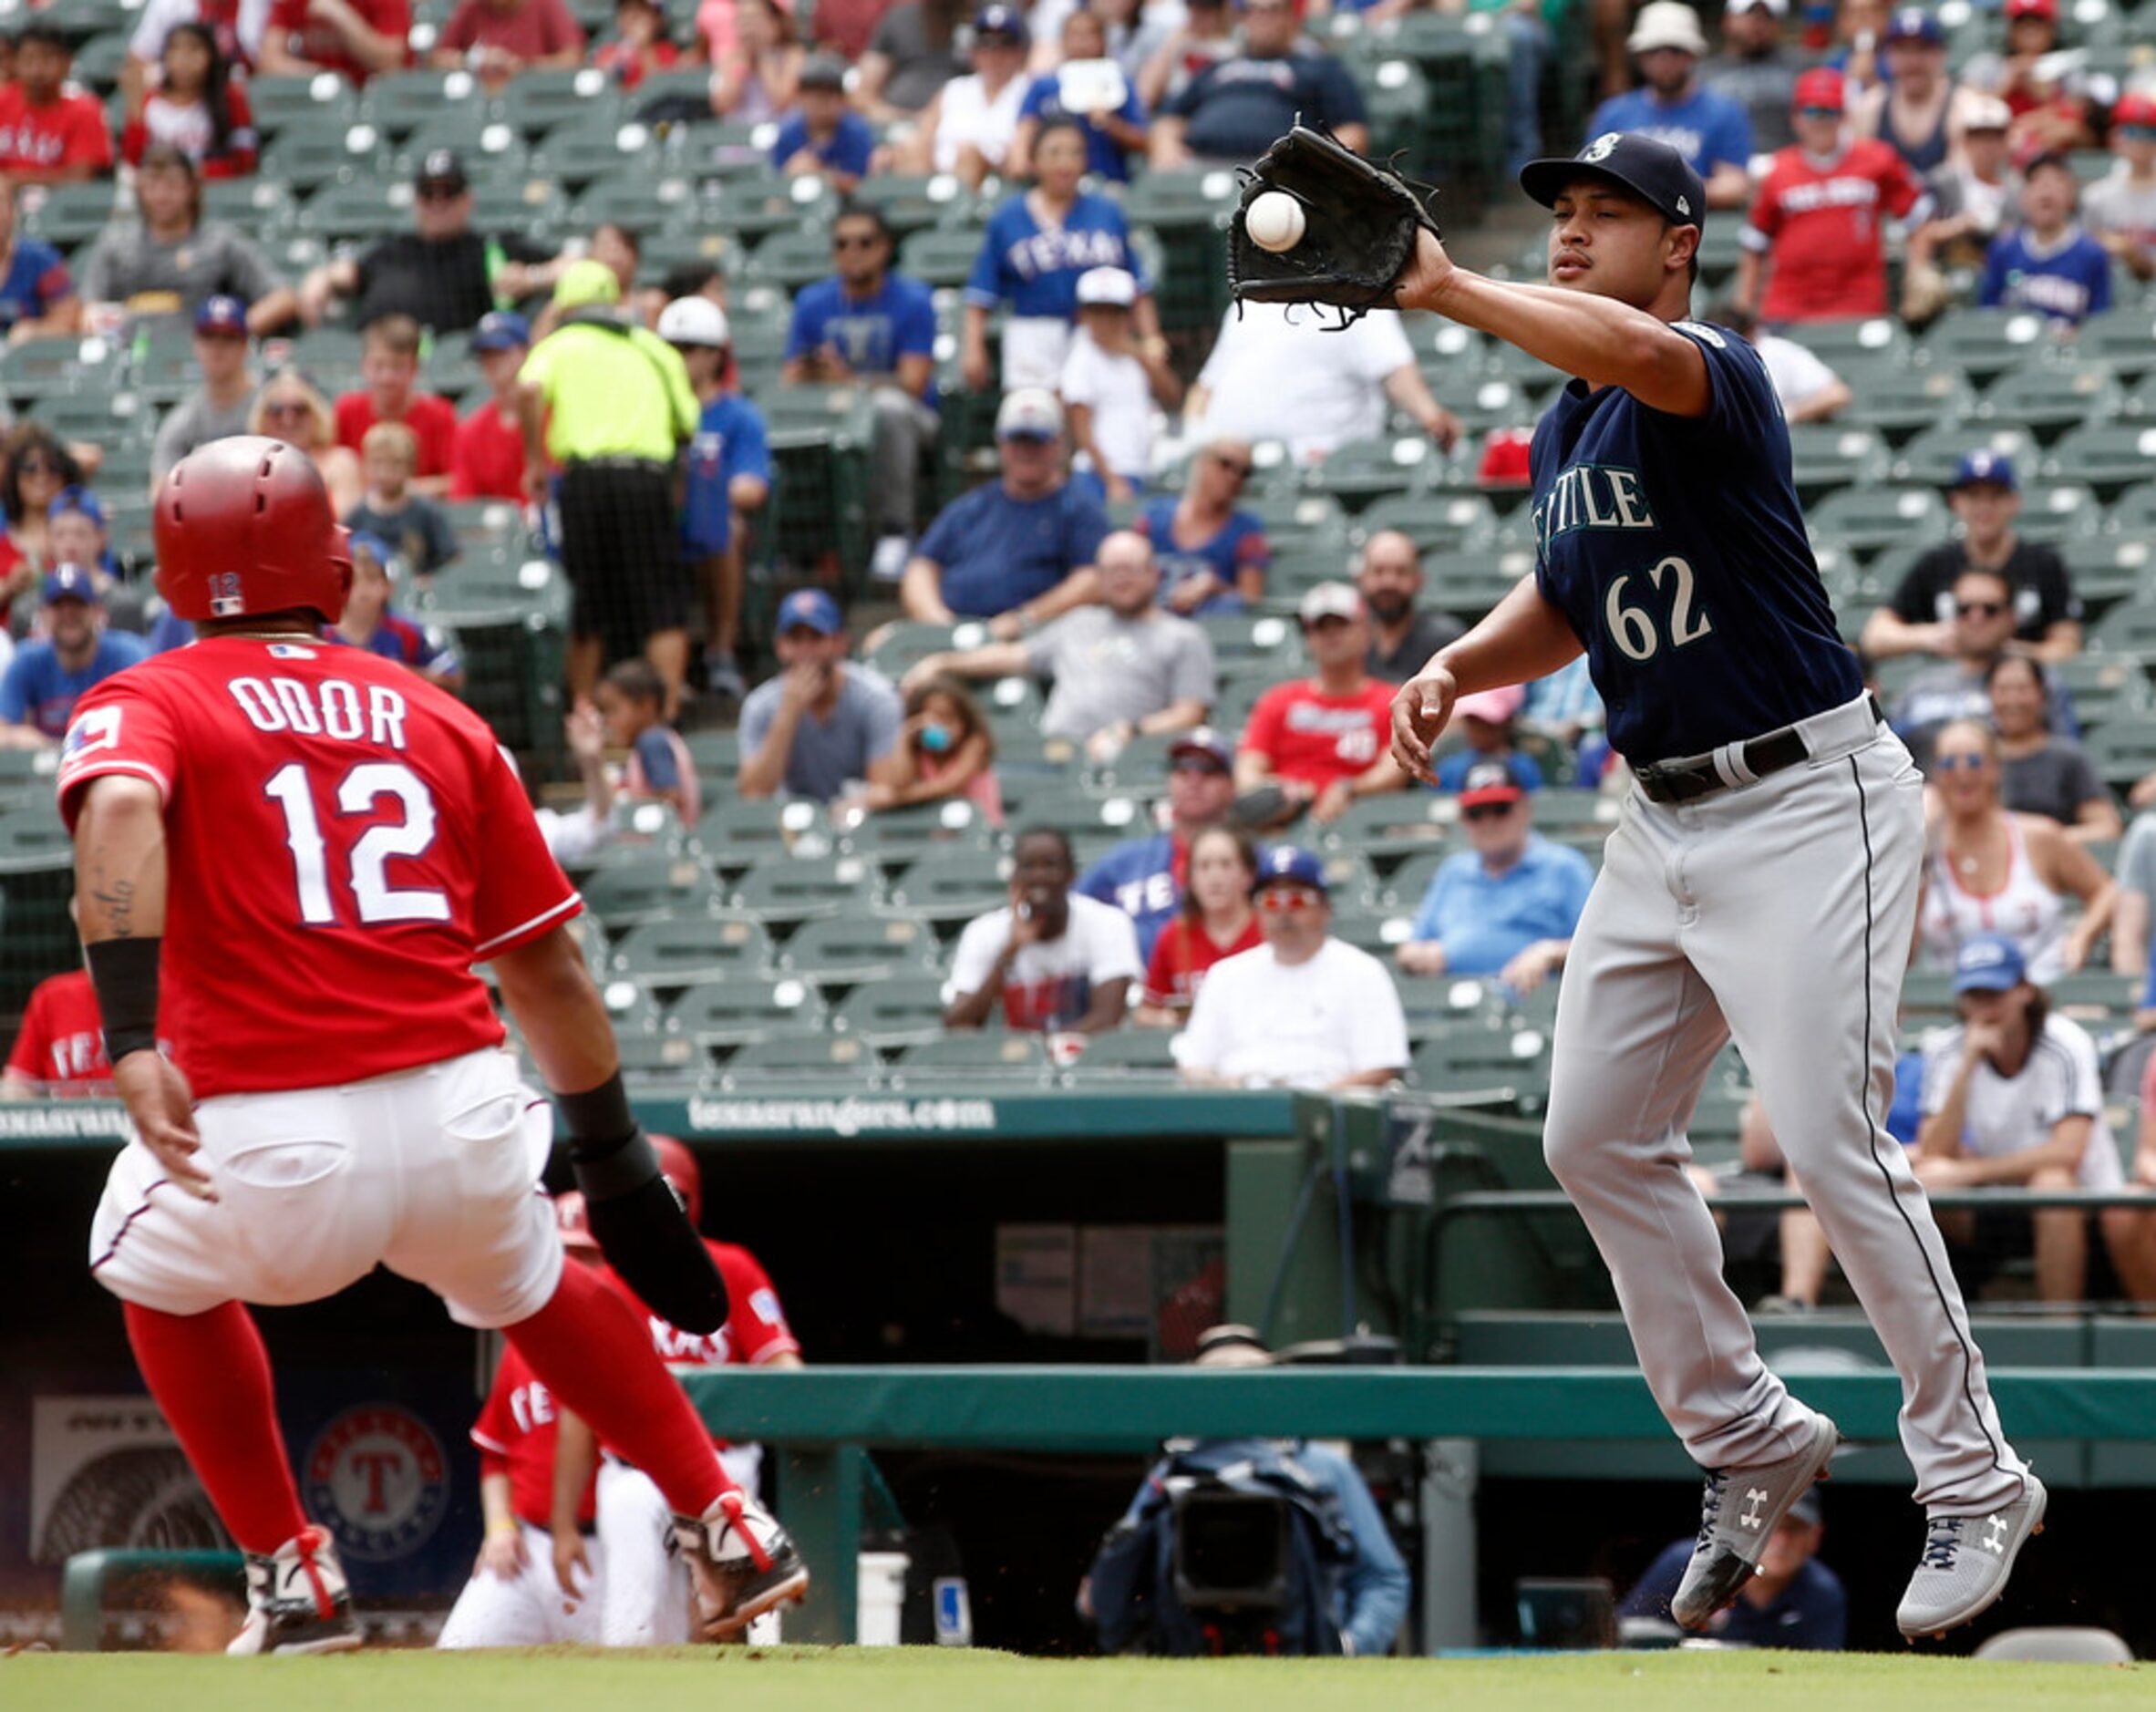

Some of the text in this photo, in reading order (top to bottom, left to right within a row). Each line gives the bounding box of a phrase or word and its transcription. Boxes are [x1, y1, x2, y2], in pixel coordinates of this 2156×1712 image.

[208, 572, 241, 598] 12
[1605, 555, 1713, 661] 62
[227, 676, 407, 750] ODOR
[263, 759, 453, 927] 12
[687, 1095, 995, 1137] texasrangers.com
[510, 1379, 554, 1435] TE
